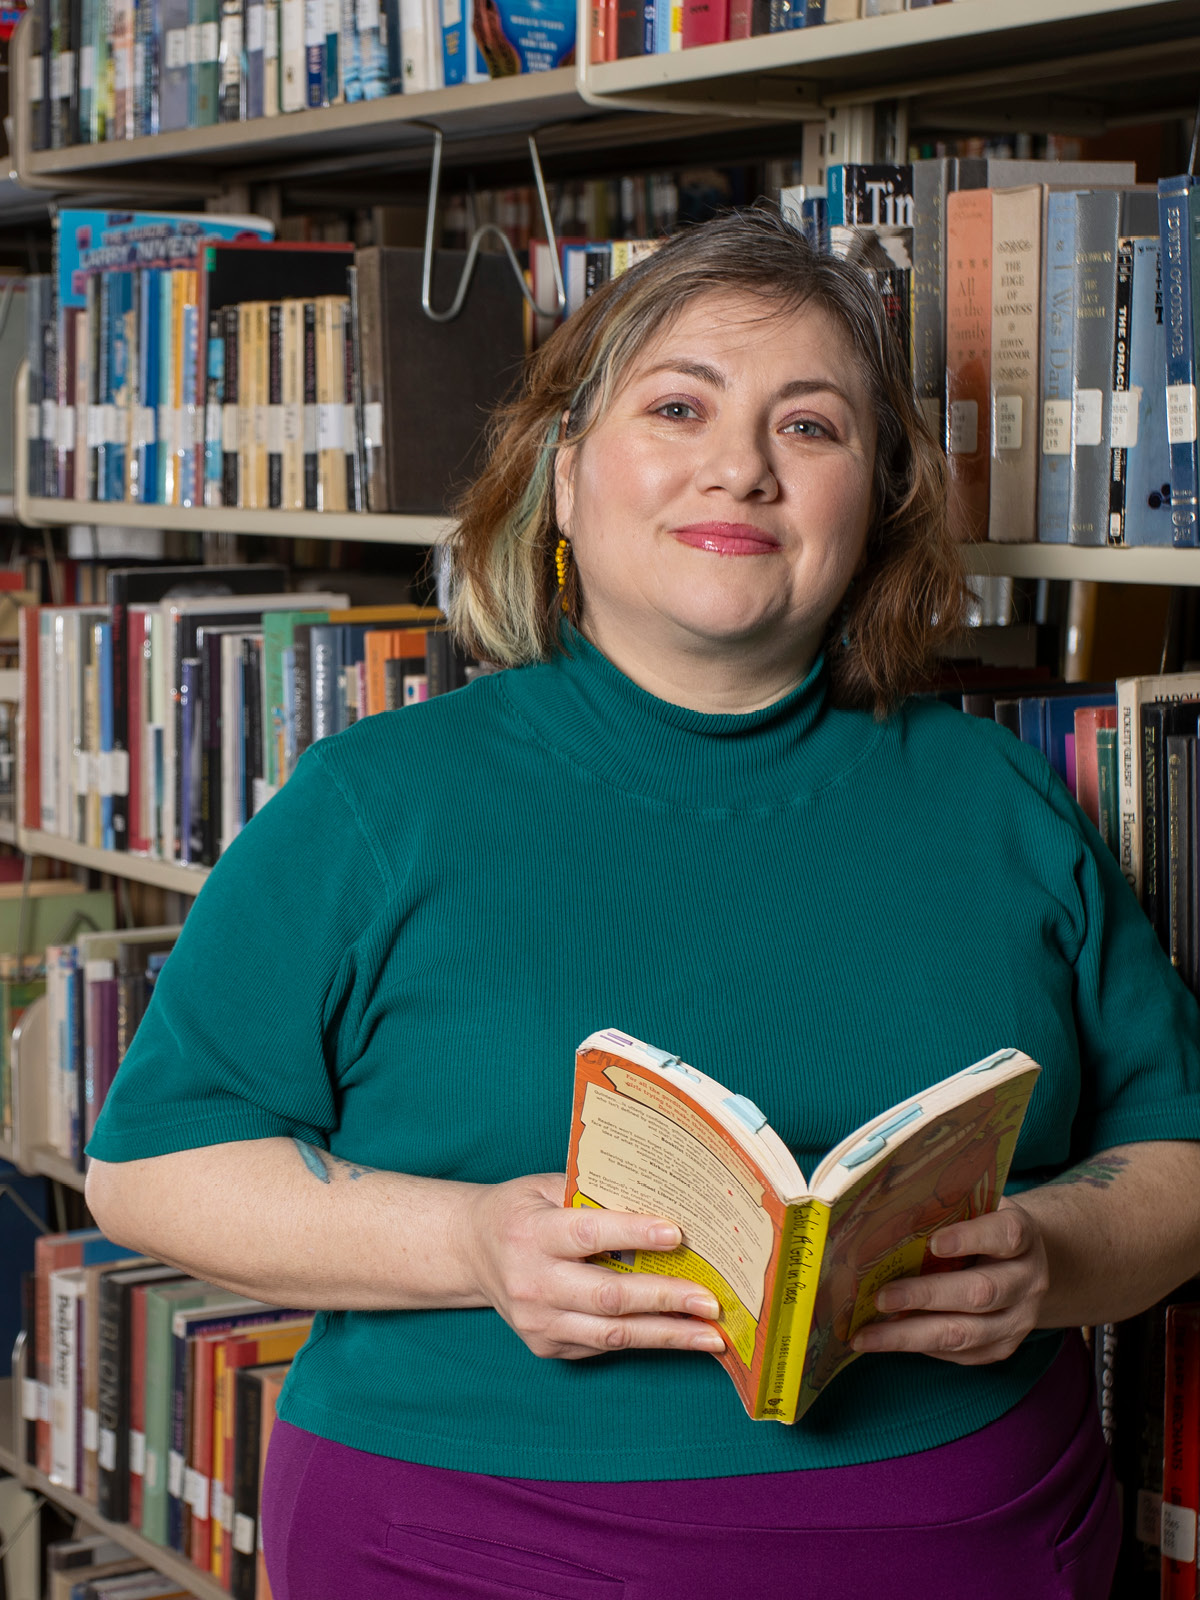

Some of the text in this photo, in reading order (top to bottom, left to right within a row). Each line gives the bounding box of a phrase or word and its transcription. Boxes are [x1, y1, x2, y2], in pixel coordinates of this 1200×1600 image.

[1001, 275, 1025, 287] EDGE
[1004, 260, 1021, 273] THE
[994, 303, 1033, 317] SADNESS
[1007, 290, 1018, 301] OF
[1116, 304, 1127, 392] THE ORACL
[1047, 347, 1072, 400] Dan
[1113, 449, 1122, 482] CONNOR
[1145, 726, 1156, 806] FLANNERY
[790, 1247, 814, 1269] Girl
[788, 1269, 806, 1280] in
[779, 1334, 792, 1361] ISABEL
[99, 1319, 120, 1430] BLOND
[774, 1361, 790, 1395] QUINTERO
[1102, 1322, 1116, 1445] ckroads
